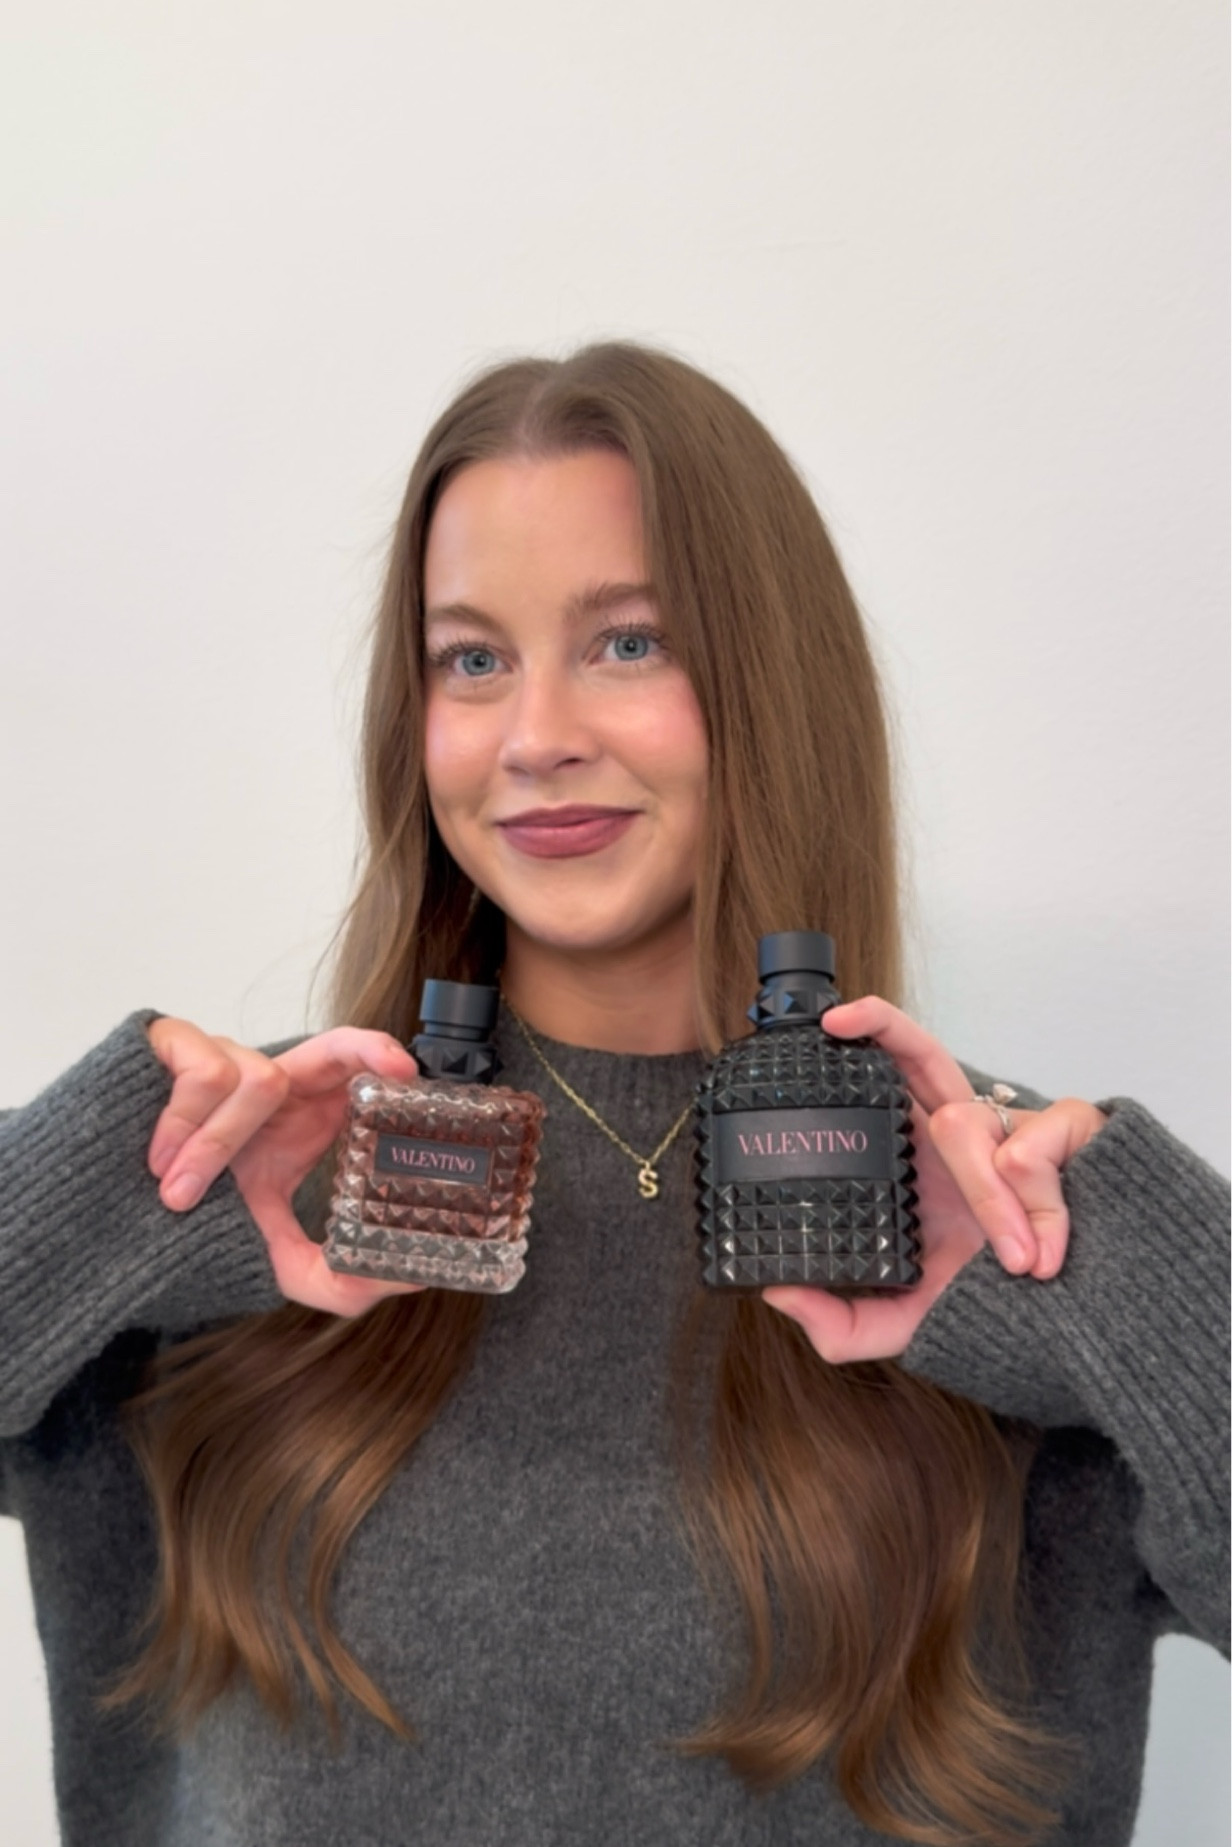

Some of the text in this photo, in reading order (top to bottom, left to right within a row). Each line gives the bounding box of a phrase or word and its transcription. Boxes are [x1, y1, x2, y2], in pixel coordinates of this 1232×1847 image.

[738, 1130, 868, 1156] VALENTINO
[391, 1146, 475, 1174] VALENTINO
[638, 1169, 658, 1198] S
